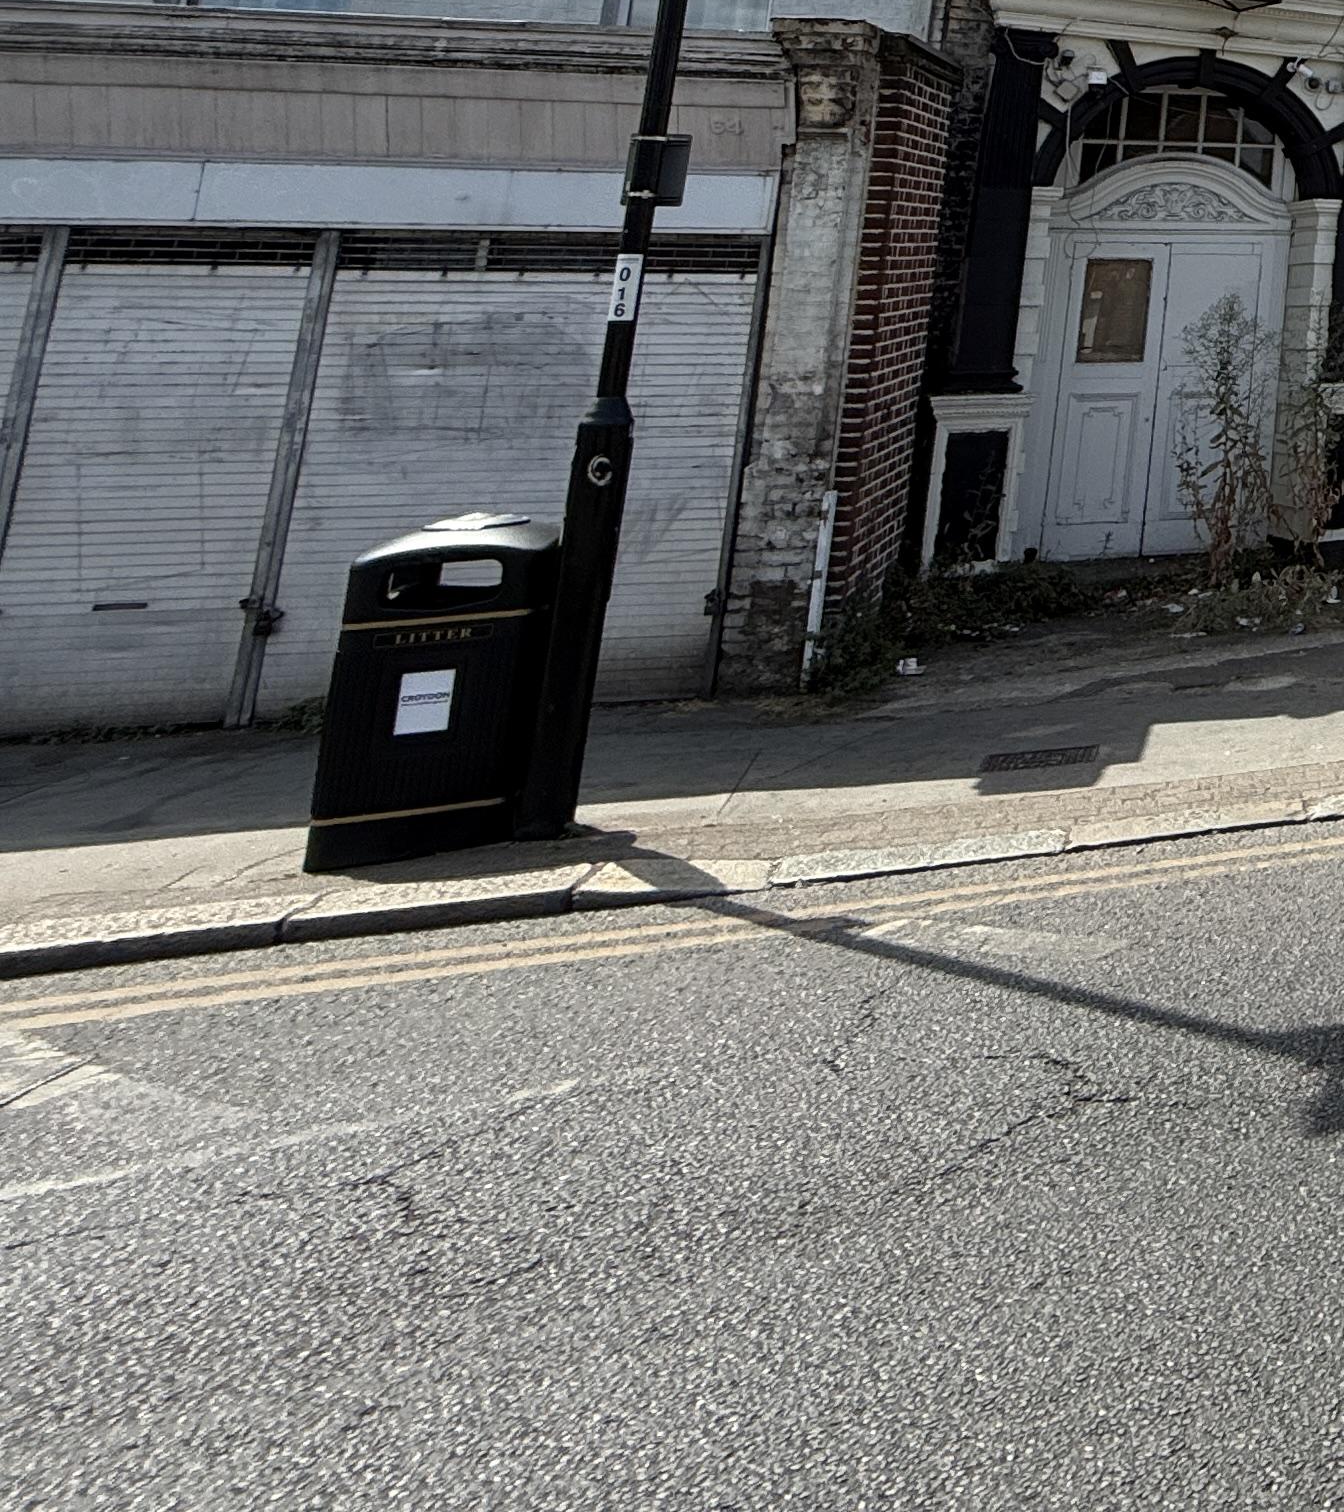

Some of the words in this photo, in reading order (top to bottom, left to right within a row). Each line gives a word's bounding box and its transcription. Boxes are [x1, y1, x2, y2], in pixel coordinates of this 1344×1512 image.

[613, 266, 632, 318] 016
[395, 628, 473, 644] LITTER
[401, 692, 451, 703] CROYDON
